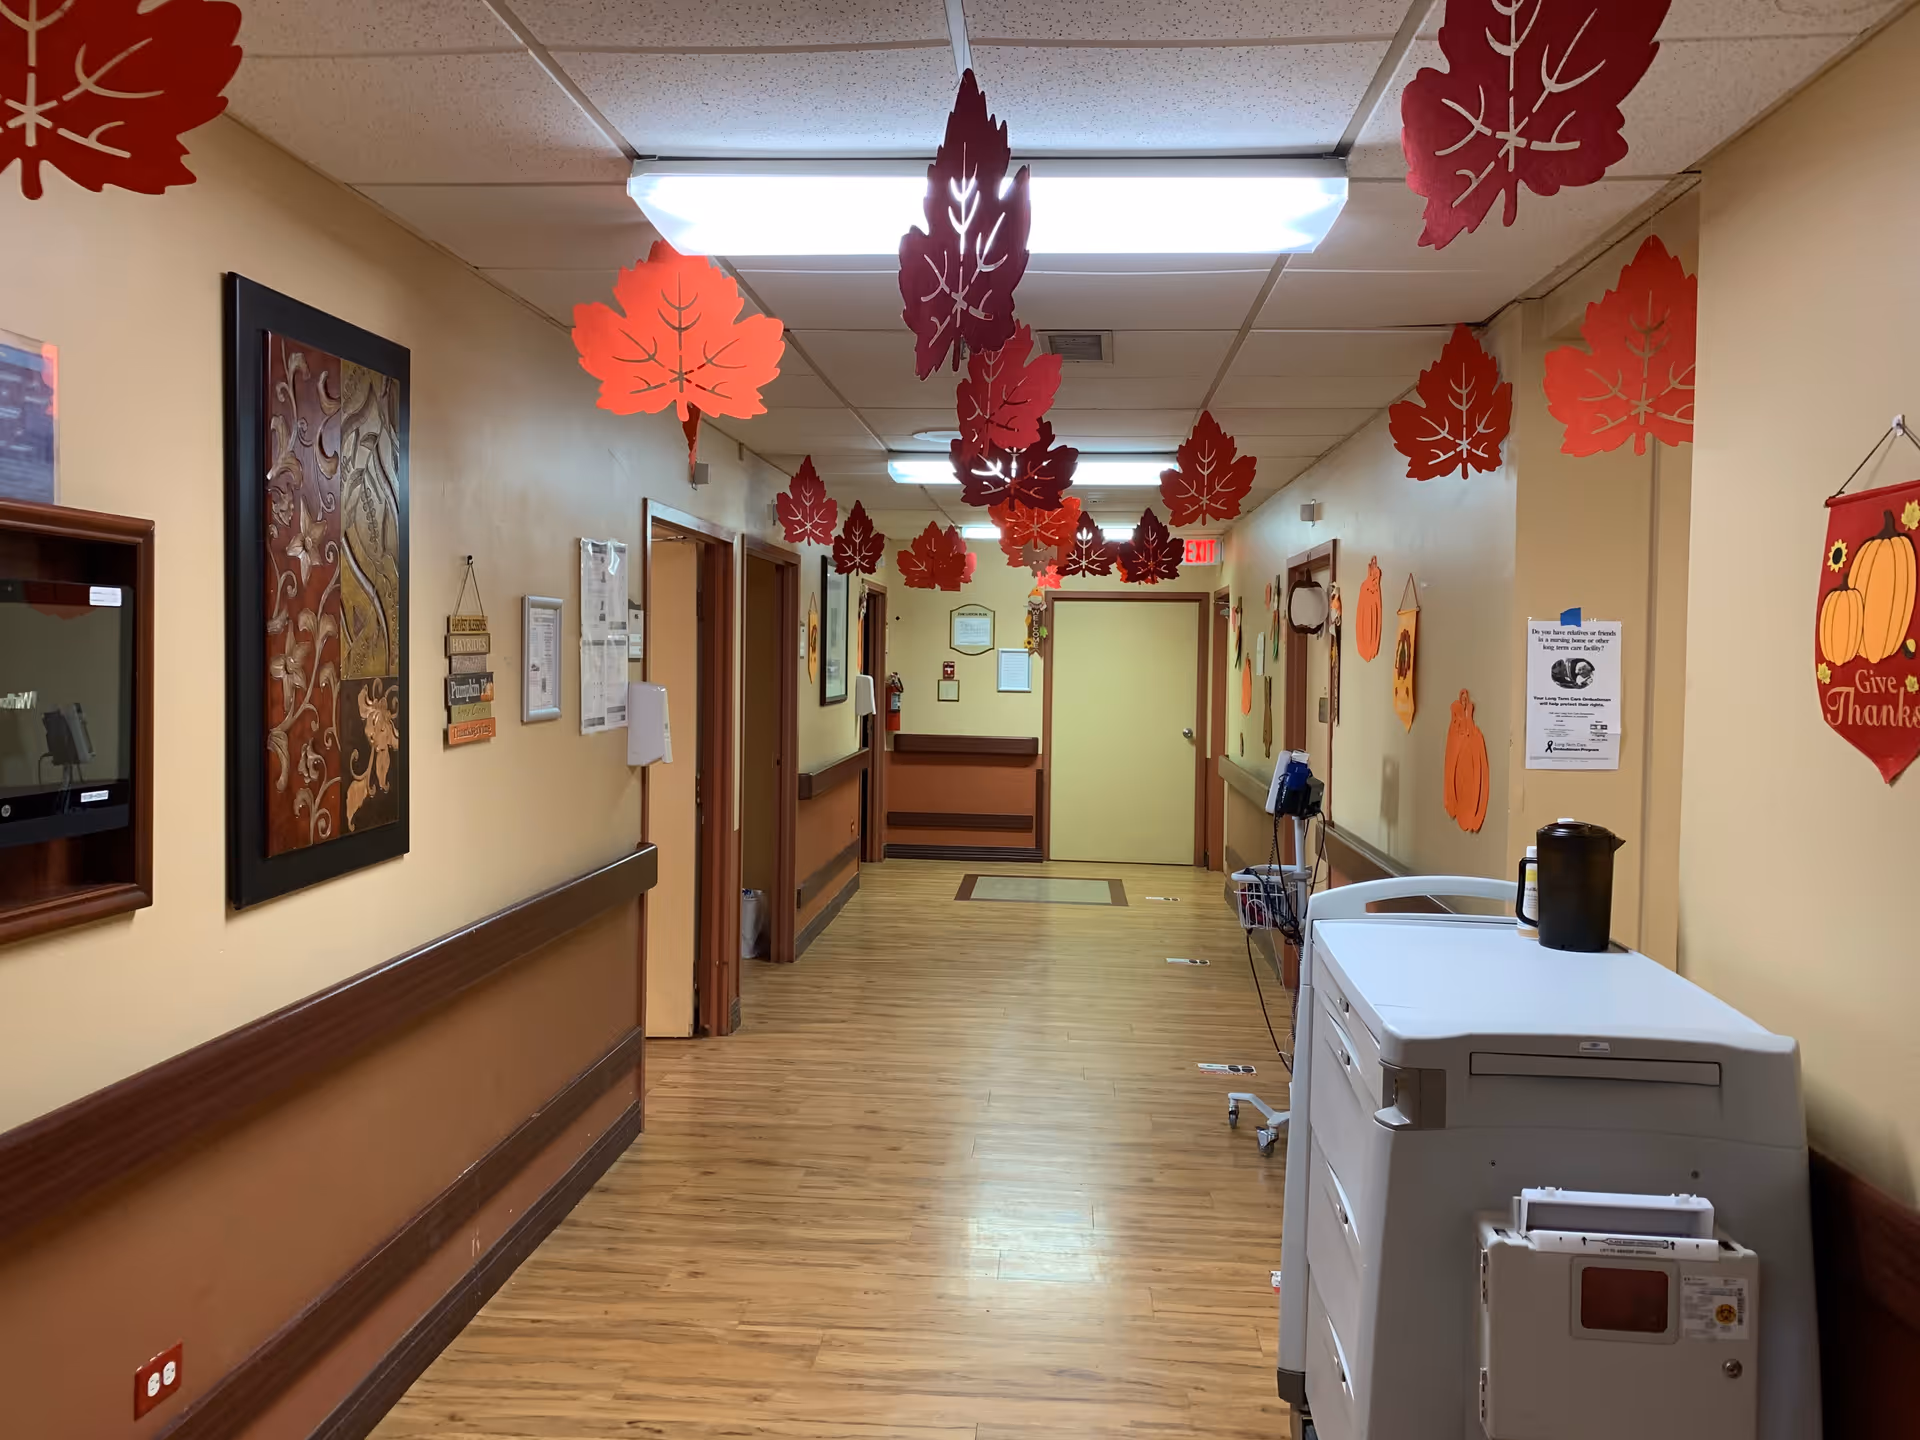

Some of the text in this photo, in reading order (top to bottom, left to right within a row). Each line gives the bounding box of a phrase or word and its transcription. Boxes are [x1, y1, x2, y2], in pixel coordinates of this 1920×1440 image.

[1185, 539, 1216, 563] EXIT
[1032, 609, 1040, 649] WELCOME
[452, 638, 487, 652] HAYRIDES
[450, 678, 480, 702] Pumpkin
[1855, 669, 1898, 694] Give
[1826, 686, 1920, 728] Thanks
[452, 723, 493, 740] Thanksgiving
